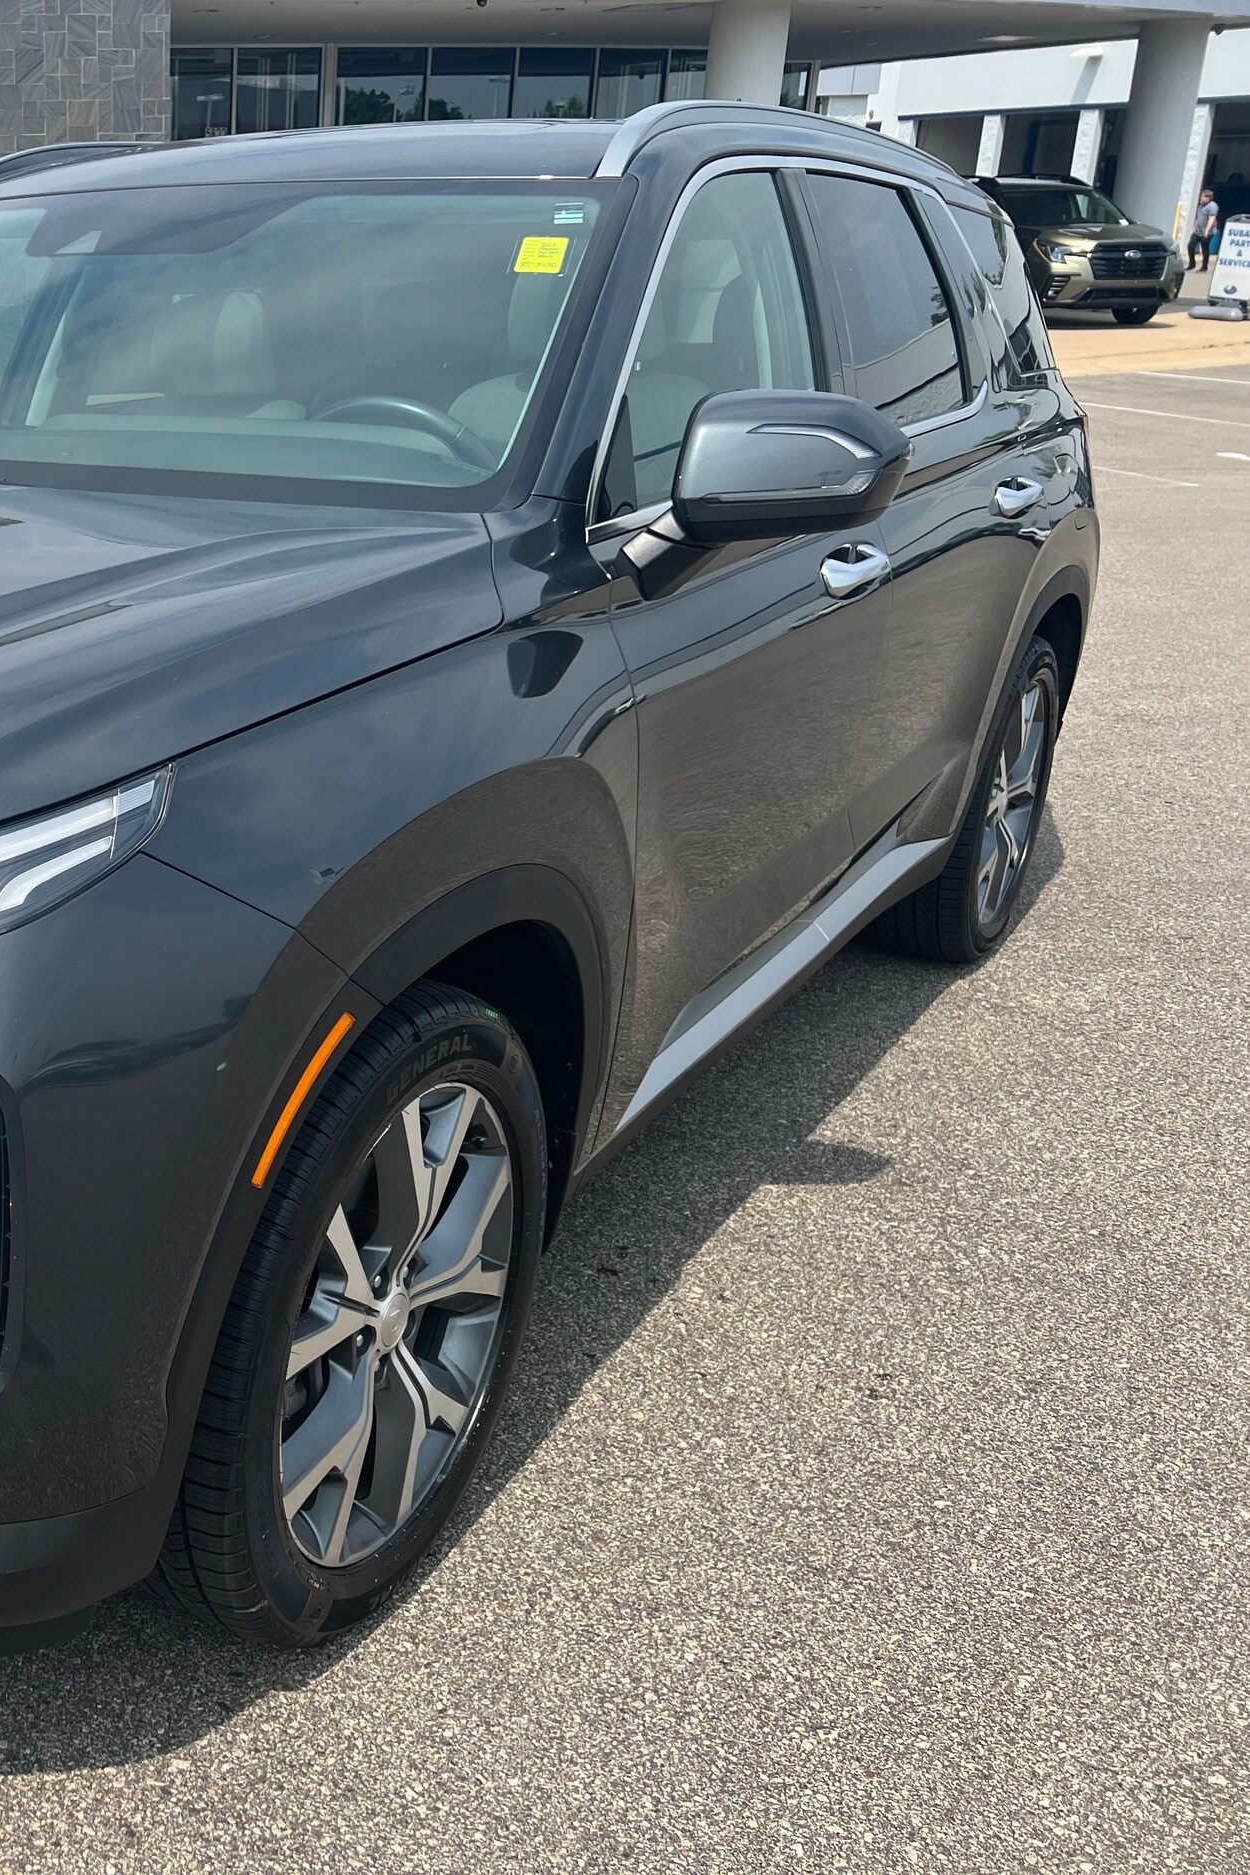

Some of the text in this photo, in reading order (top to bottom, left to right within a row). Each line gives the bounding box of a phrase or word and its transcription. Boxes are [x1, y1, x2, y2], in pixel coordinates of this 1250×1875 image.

[1230, 239, 1250, 248] PART
[1236, 249, 1242, 257] &
[1219, 258, 1250, 268] SERVICE
[386, 1034, 473, 1105] GENERAL
